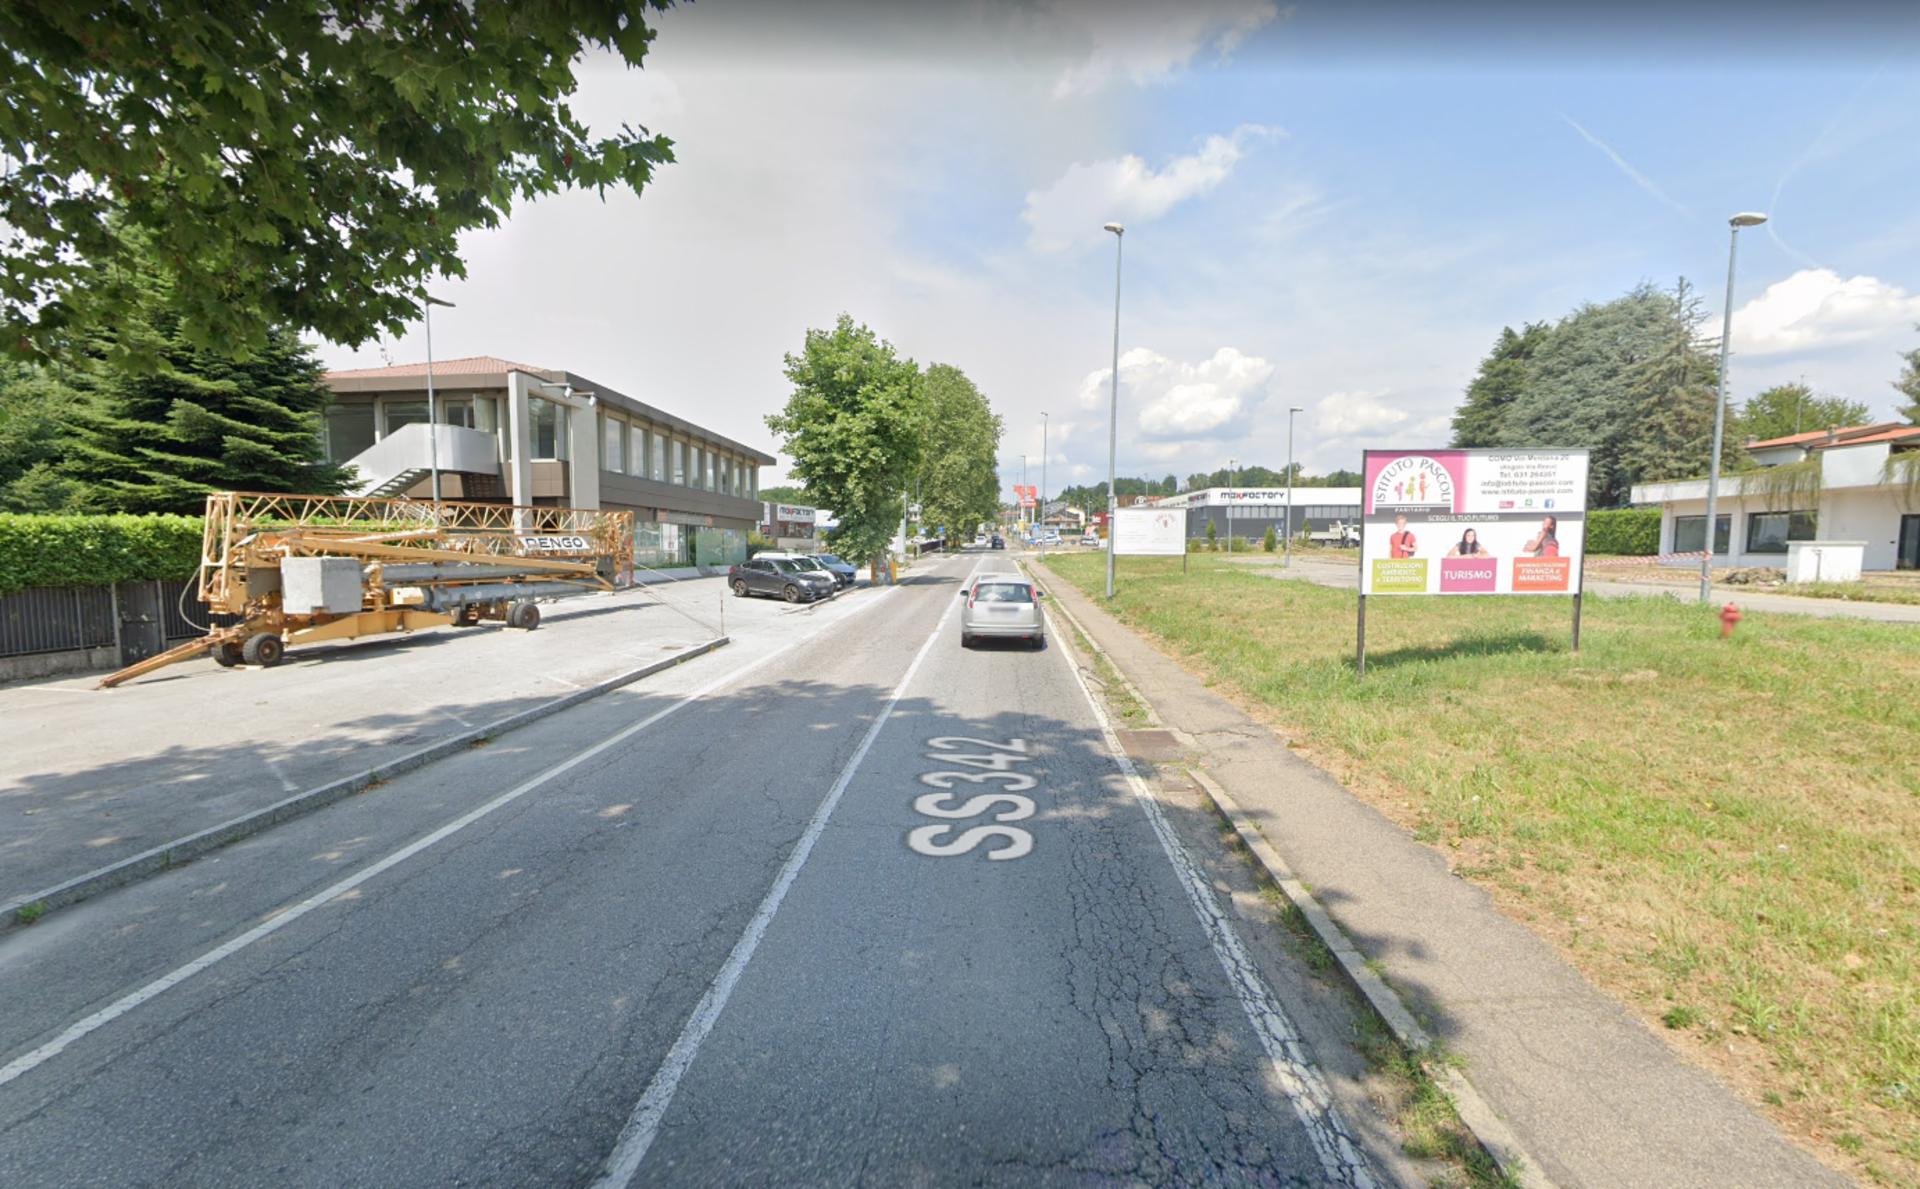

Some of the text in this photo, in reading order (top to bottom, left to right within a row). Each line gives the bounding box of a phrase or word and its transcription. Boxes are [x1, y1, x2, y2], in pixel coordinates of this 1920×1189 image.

[1376, 458, 1451, 502] ISTITUTO PASCOLI
[1444, 570, 1493, 581] TURISMO
[908, 736, 1038, 860] SS342
